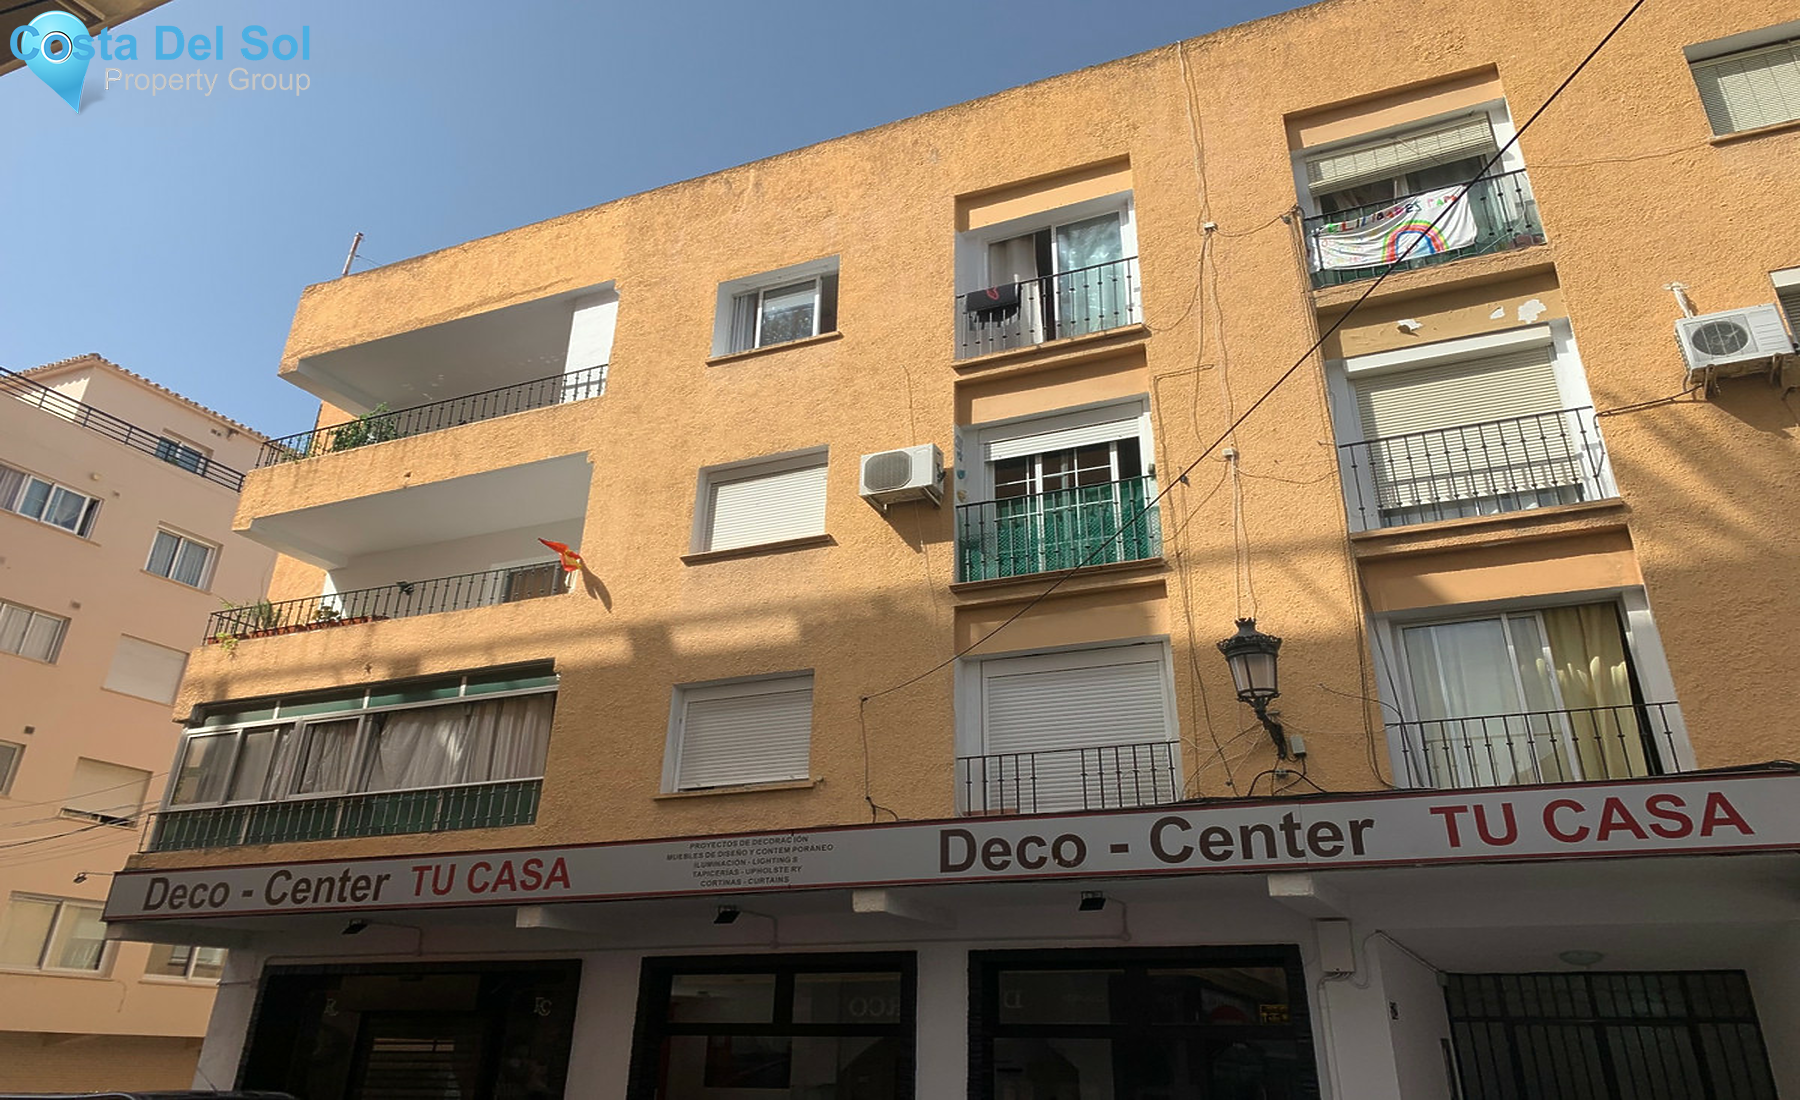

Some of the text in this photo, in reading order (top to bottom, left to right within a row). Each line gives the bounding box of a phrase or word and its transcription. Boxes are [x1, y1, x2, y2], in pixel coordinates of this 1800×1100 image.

[689, 840, 738, 850] PROYECTOS
[739, 838, 750, 847] DE
[940, 791, 1755, 873] Deco - Center TU CASA
[142, 857, 571, 911] Deco - Center TU CASA
